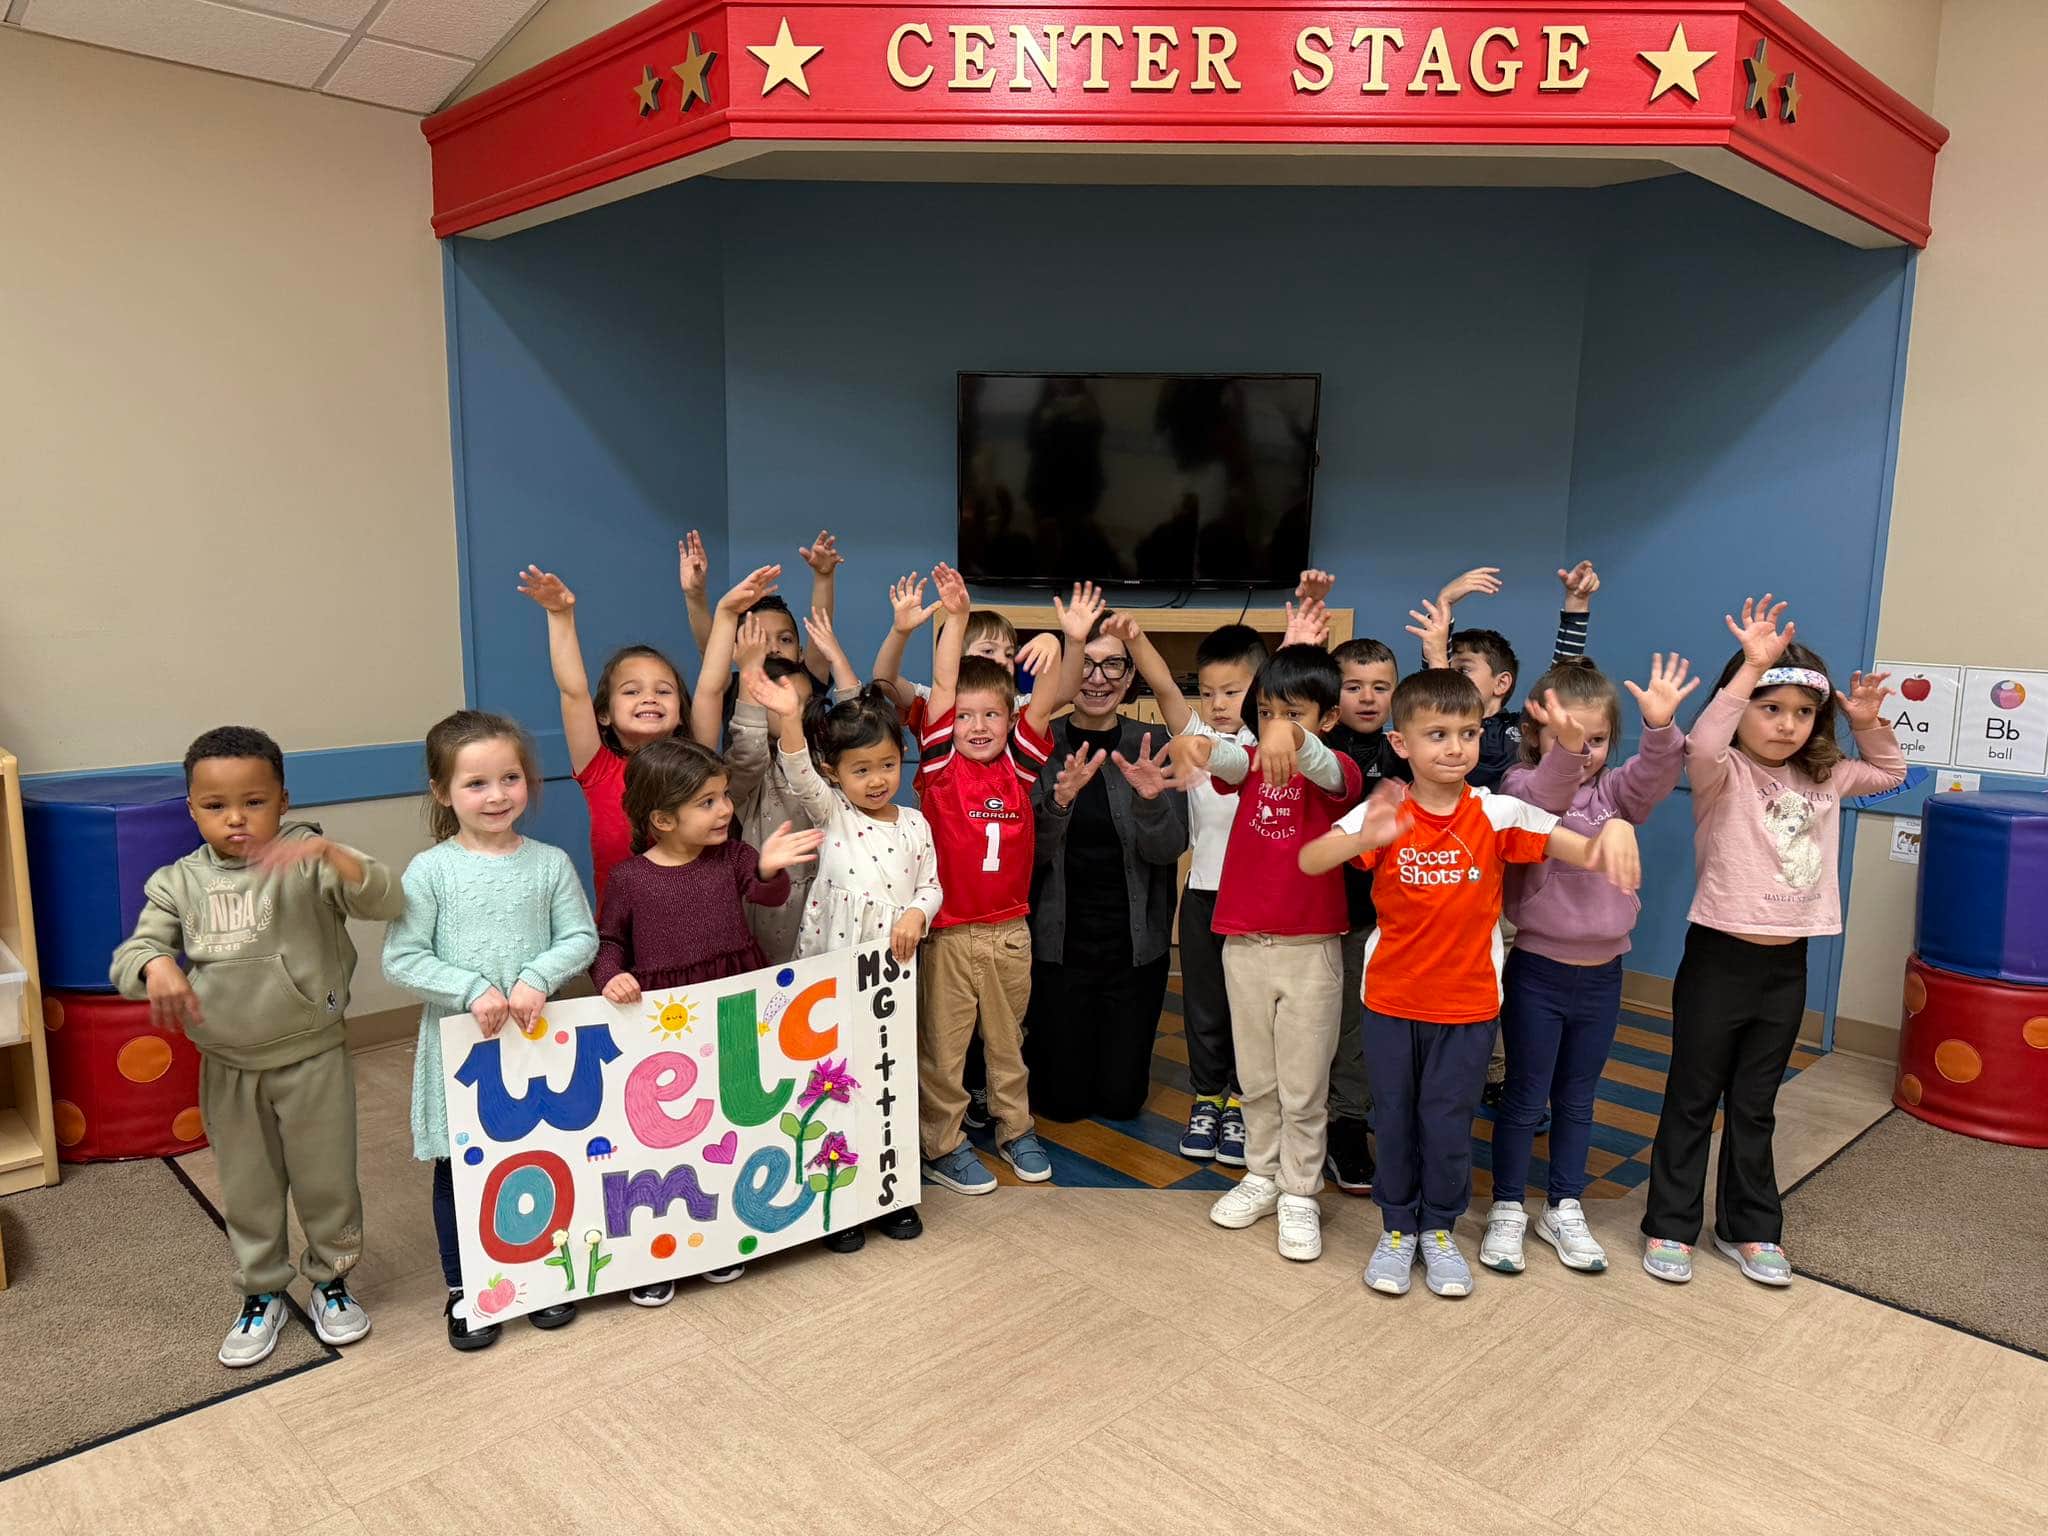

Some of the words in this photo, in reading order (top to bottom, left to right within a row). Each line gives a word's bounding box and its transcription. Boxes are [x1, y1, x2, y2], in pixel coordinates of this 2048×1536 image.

[886, 22, 1242, 91] CENTER
[1291, 25, 1590, 93] STAGE
[1893, 711, 1929, 733] Aa
[1985, 717, 2020, 741] Bb
[1900, 739, 1926, 755] pple
[1988, 746, 2012, 760] ball
[969, 810, 1017, 819] GEORGIA
[982, 822, 1000, 872] 1
[1397, 847, 1461, 866] Soccer
[1400, 864, 1462, 886] Shots
[209, 890, 257, 933] NBA
